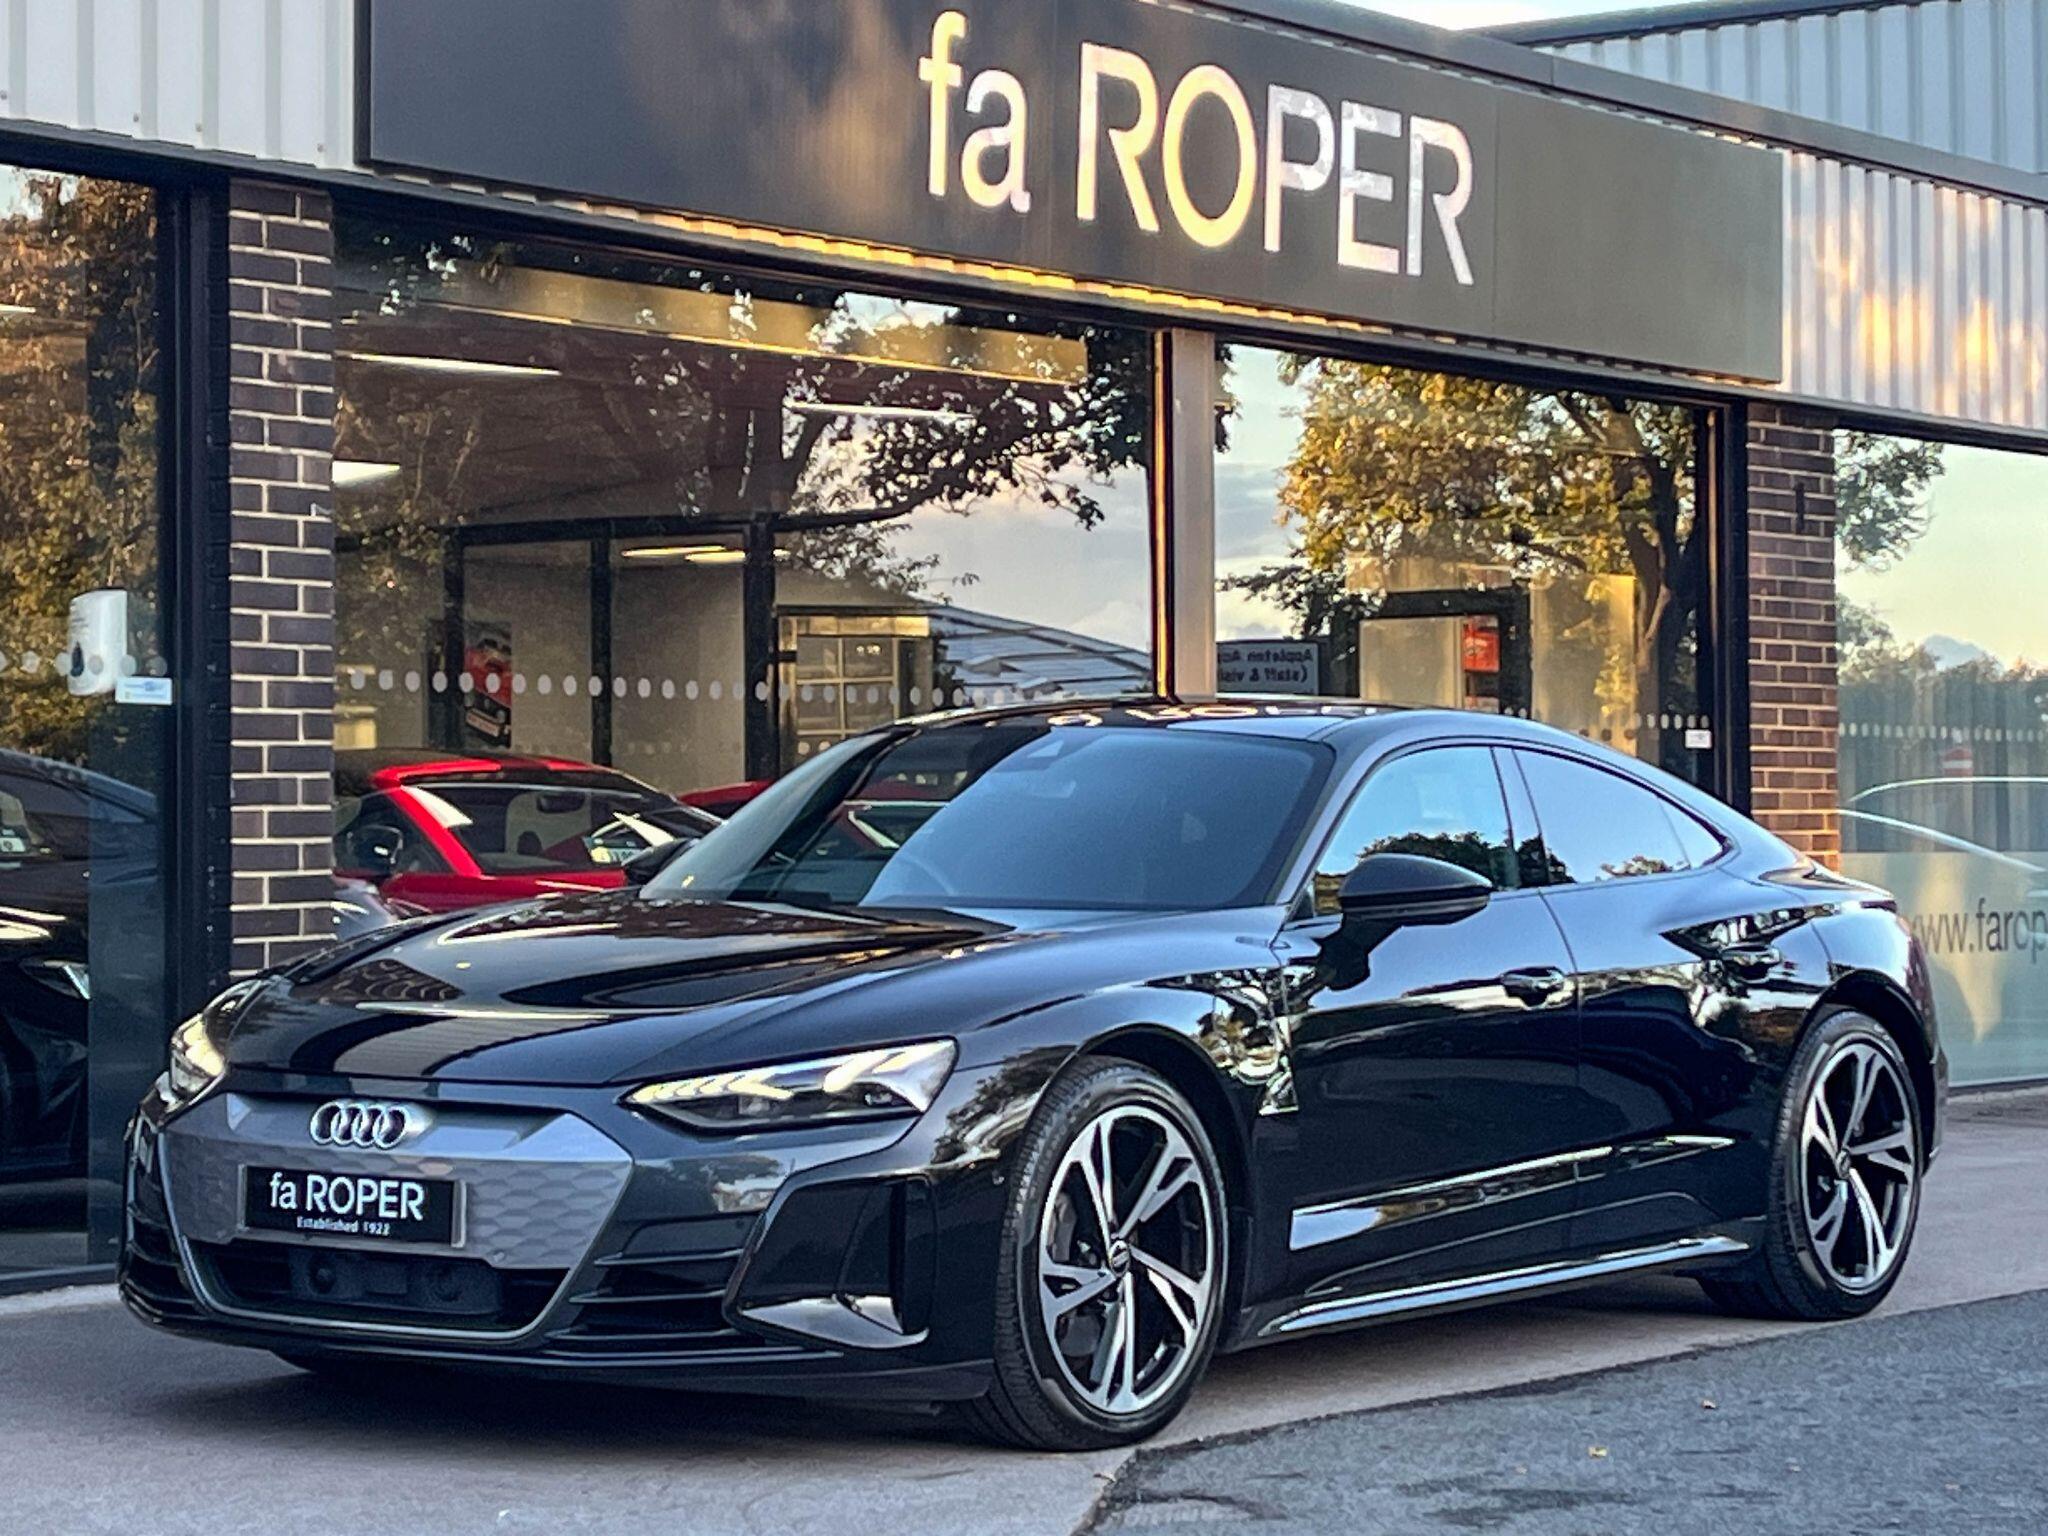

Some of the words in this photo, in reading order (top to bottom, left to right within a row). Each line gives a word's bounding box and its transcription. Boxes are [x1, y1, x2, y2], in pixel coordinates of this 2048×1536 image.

[918, 10, 1031, 213] fa
[1077, 41, 1474, 286] ROPER
[269, 1171, 298, 1210] fa
[305, 1174, 424, 1221] ROPER
[296, 1215, 359, 1233] Established
